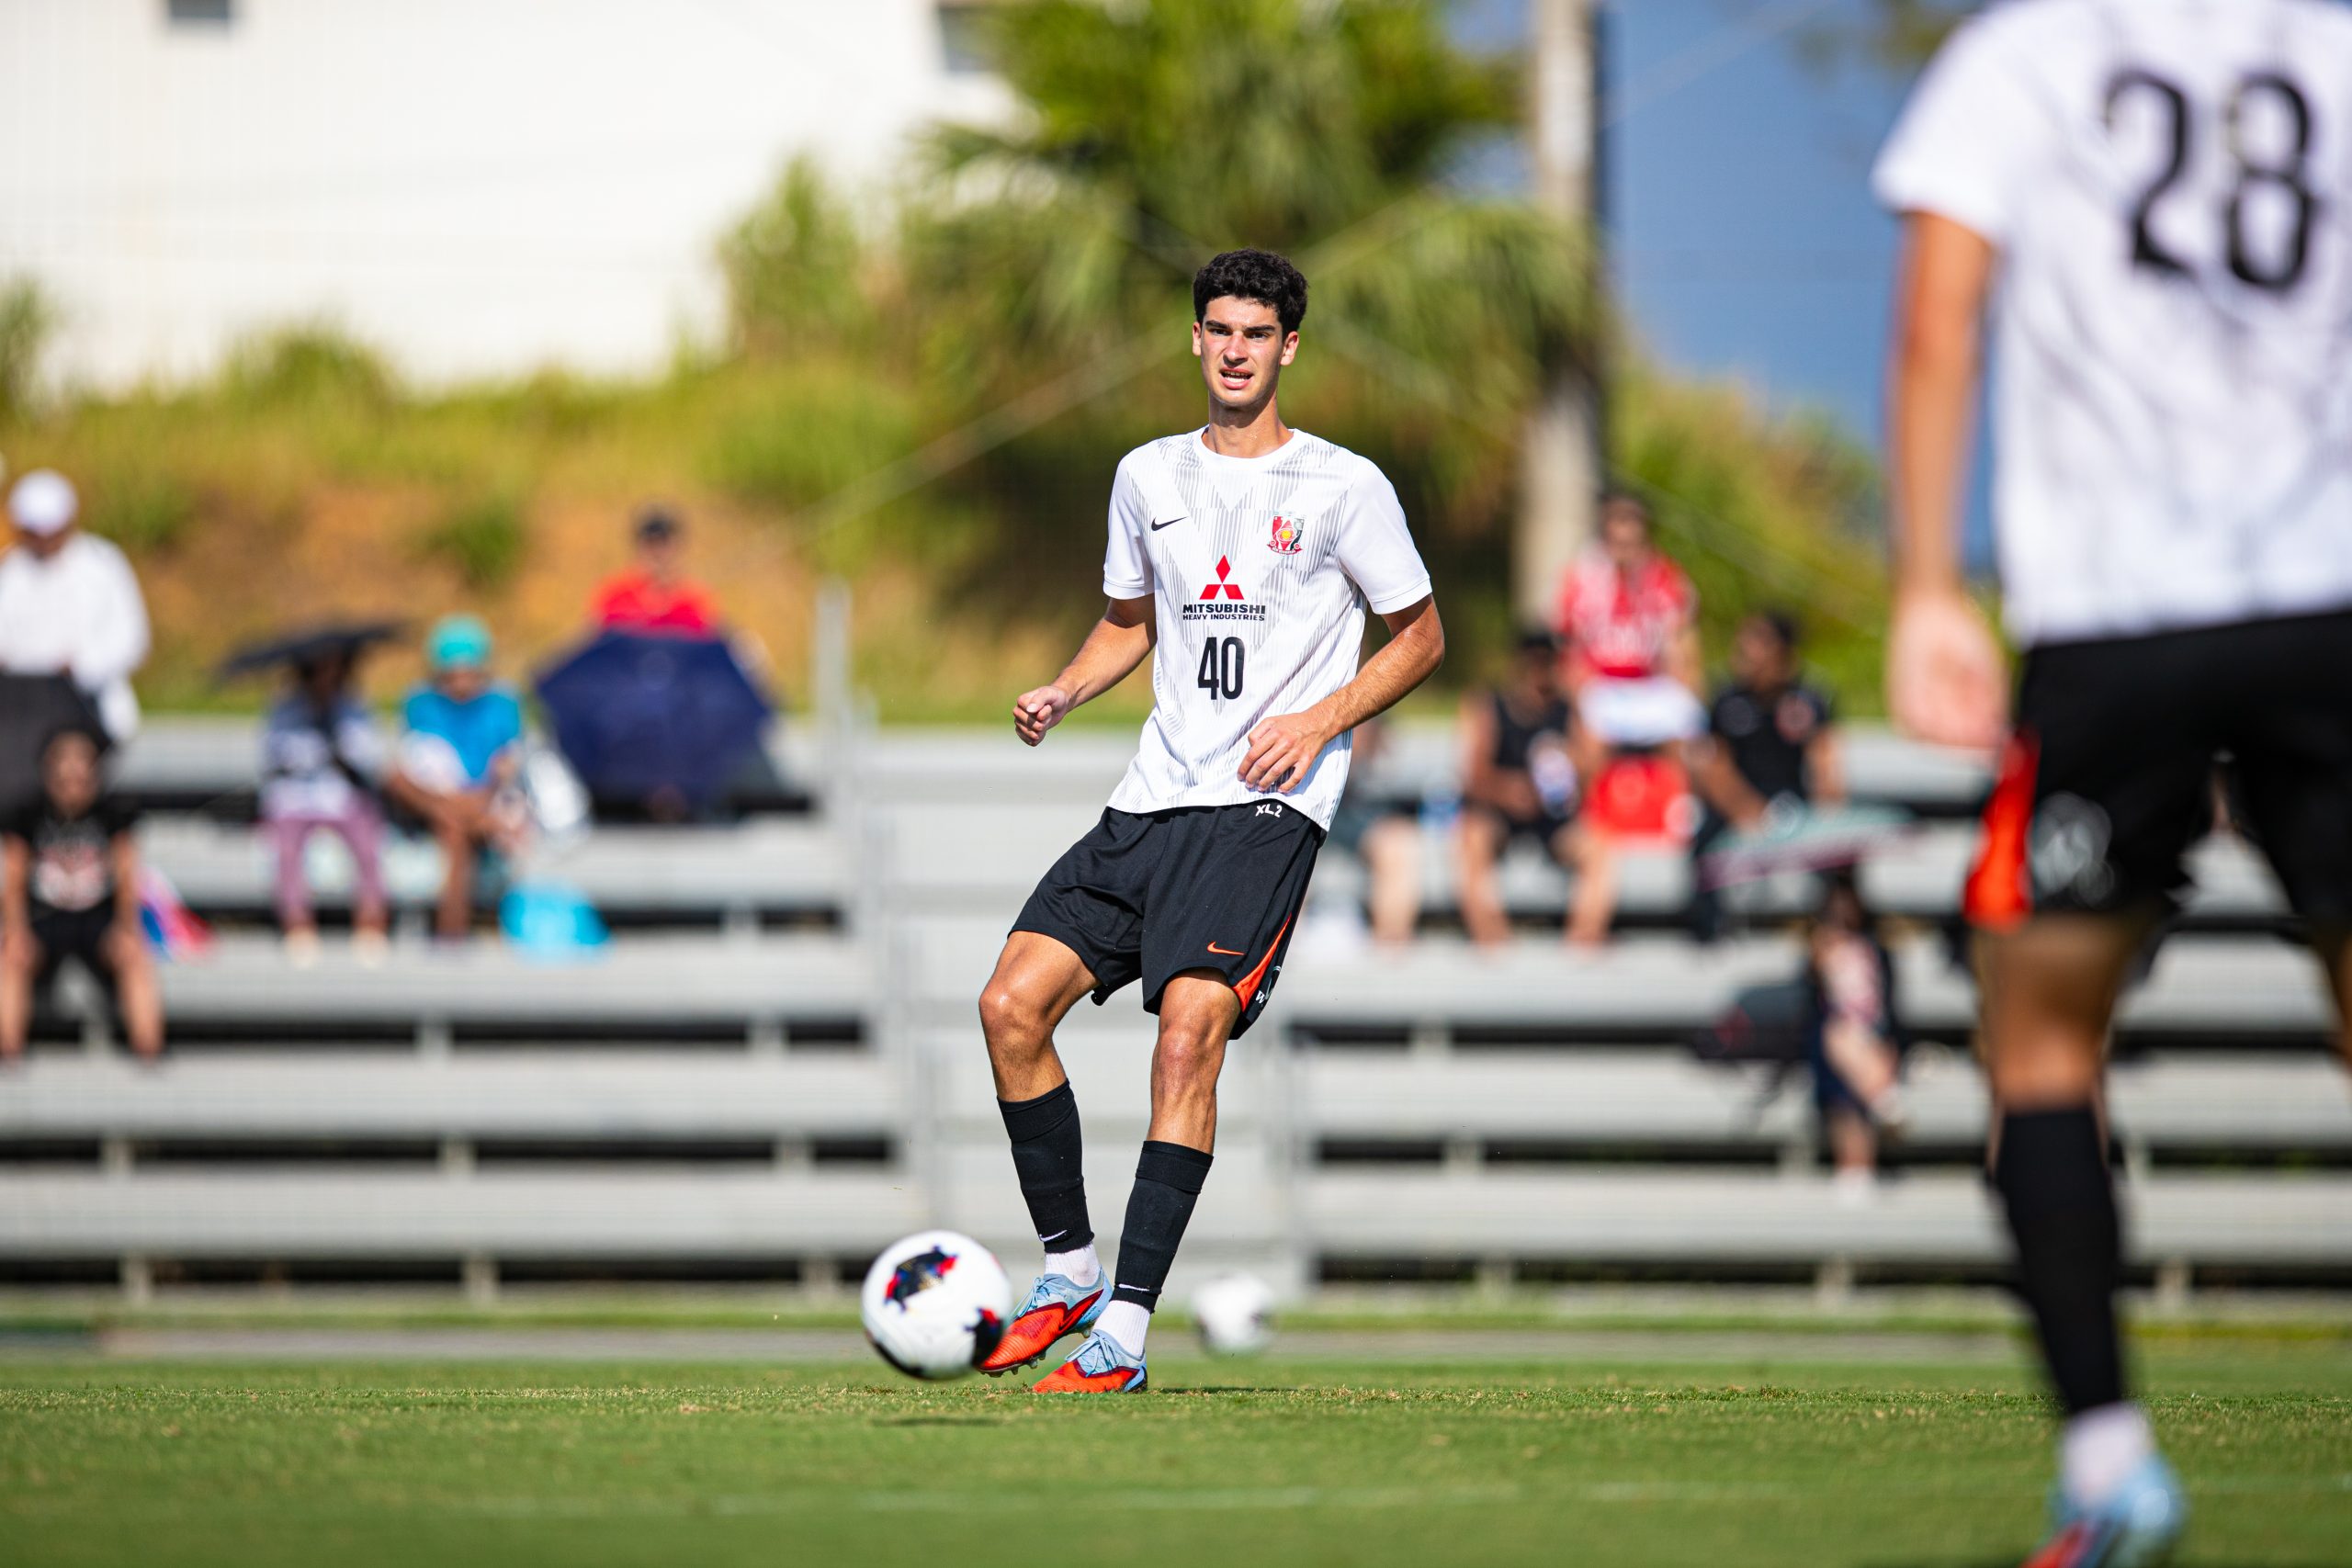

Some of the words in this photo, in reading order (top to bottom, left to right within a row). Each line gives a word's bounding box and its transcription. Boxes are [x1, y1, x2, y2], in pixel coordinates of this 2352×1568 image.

[2102, 70, 2312, 291] 28
[1182, 604, 1266, 614] MITSUBISHI
[1197, 637, 1245, 700] 40
